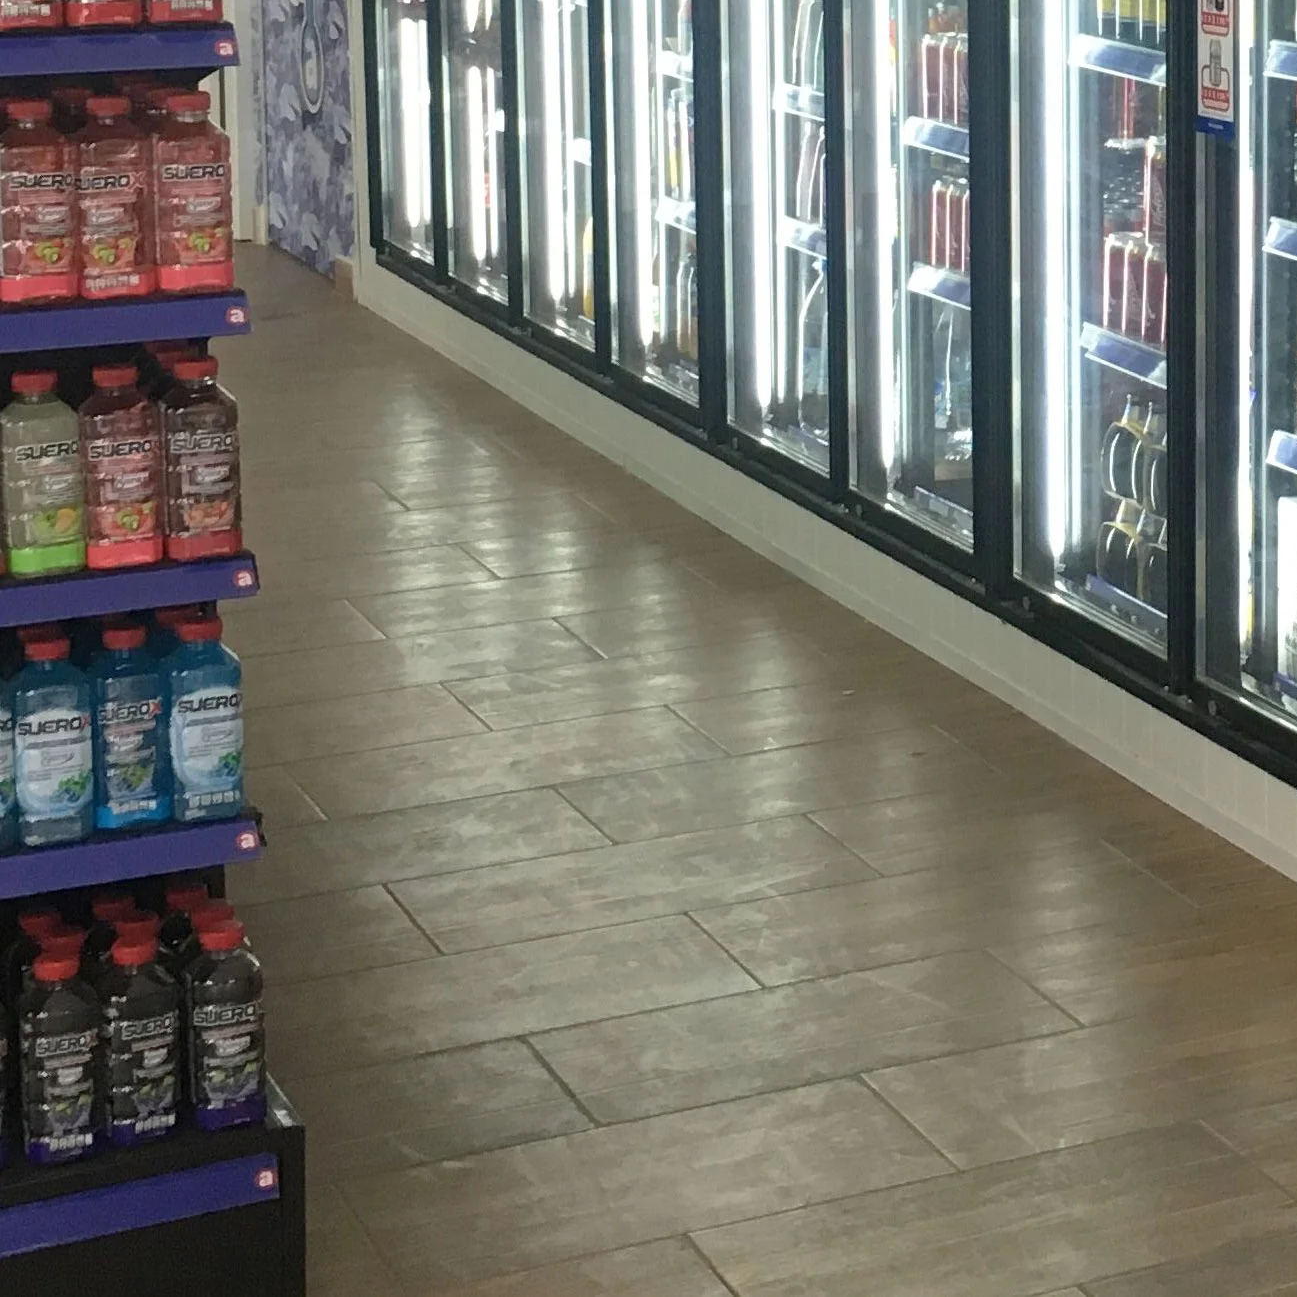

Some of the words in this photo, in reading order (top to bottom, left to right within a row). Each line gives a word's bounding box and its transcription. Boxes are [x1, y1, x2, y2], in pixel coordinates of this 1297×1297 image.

[219, 41, 234, 56] a
[229, 308, 245, 323] a
[237, 571, 252, 587] a
